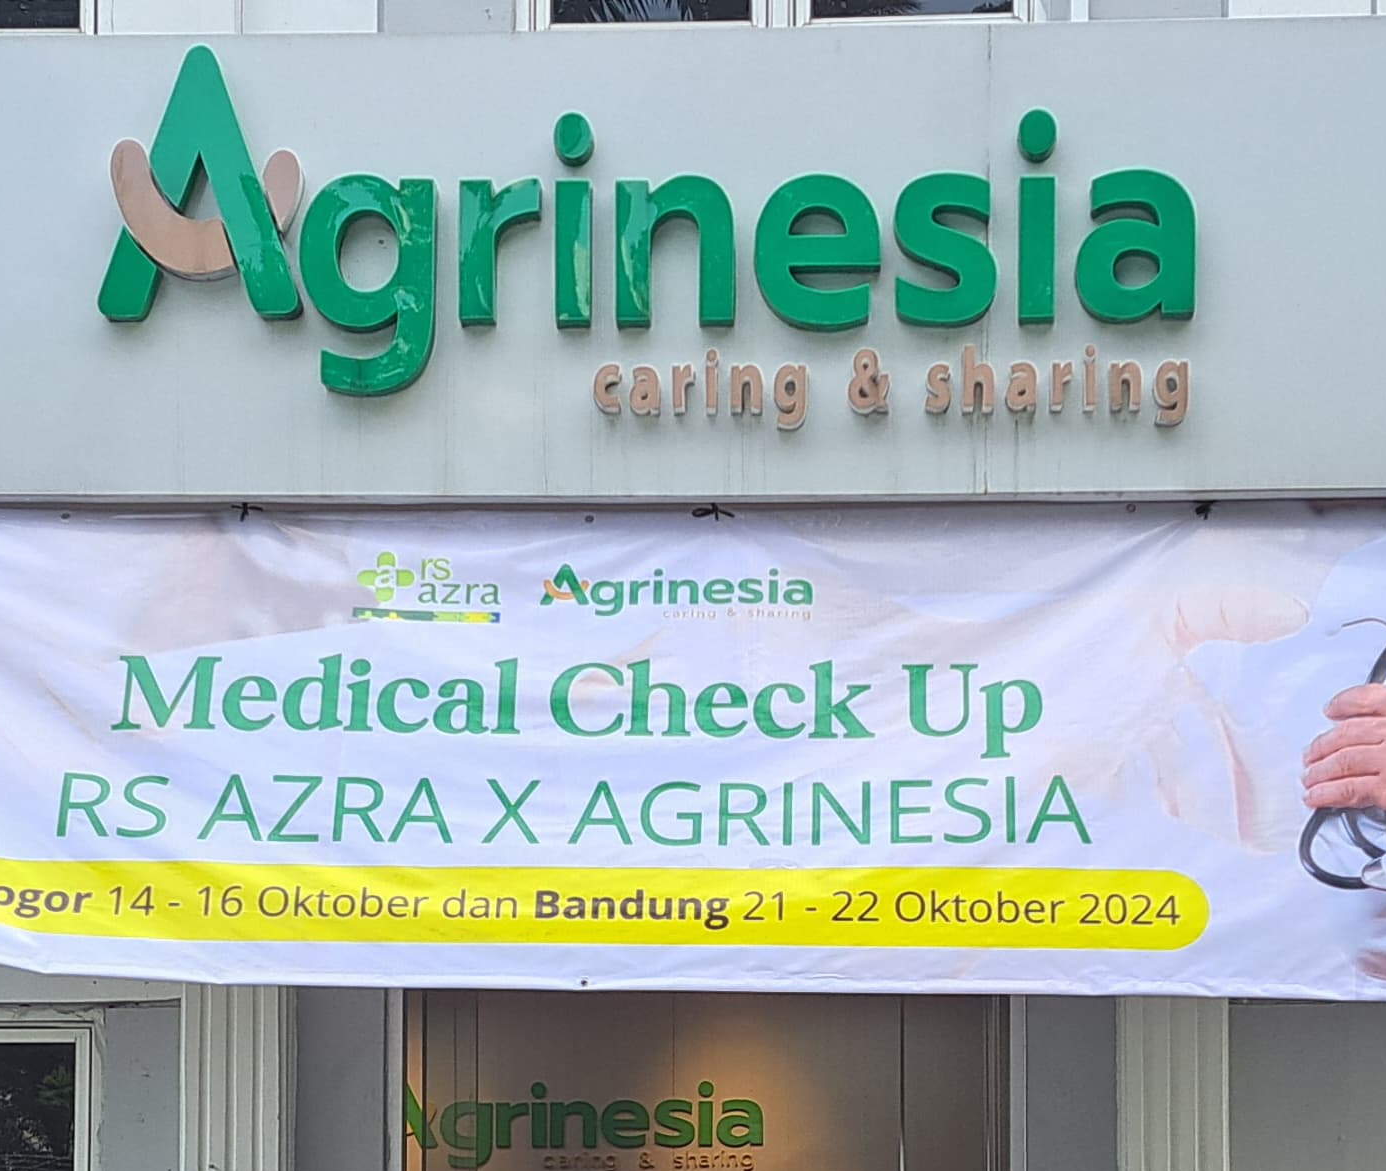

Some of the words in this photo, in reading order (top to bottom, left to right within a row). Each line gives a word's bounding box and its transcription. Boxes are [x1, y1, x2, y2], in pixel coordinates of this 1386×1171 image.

[97, 44, 1201, 396] Agrinesia
[592, 348, 811, 431] caring
[846, 347, 890, 415] &
[925, 343, 1191, 427] sharing
[417, 582, 502, 605] azra
[420, 557, 451, 581] rs
[539, 563, 814, 617] Agrinesia
[663, 607, 717, 619] caring
[726, 607, 737, 618] &
[748, 606, 812, 621] sharing
[110, 652, 521, 736] Medical
[549, 658, 876, 739] Check
[901, 662, 1044, 760] Up
[56, 771, 171, 839] RS
[196, 773, 454, 844] AZRA
[481, 777, 541, 845] X
[567, 774, 1094, 847] AGRINESIA
[106, 884, 156, 916] 14
[196, 884, 244, 918] 16
[258, 883, 430, 920] Oktober
[441, 887, 518, 920] dan
[533, 888, 729, 930] Bandung
[742, 890, 786, 922] 21
[830, 890, 880, 923] 22
[893, 888, 1065, 925] Oktober
[1078, 893, 1181, 927] 2024
